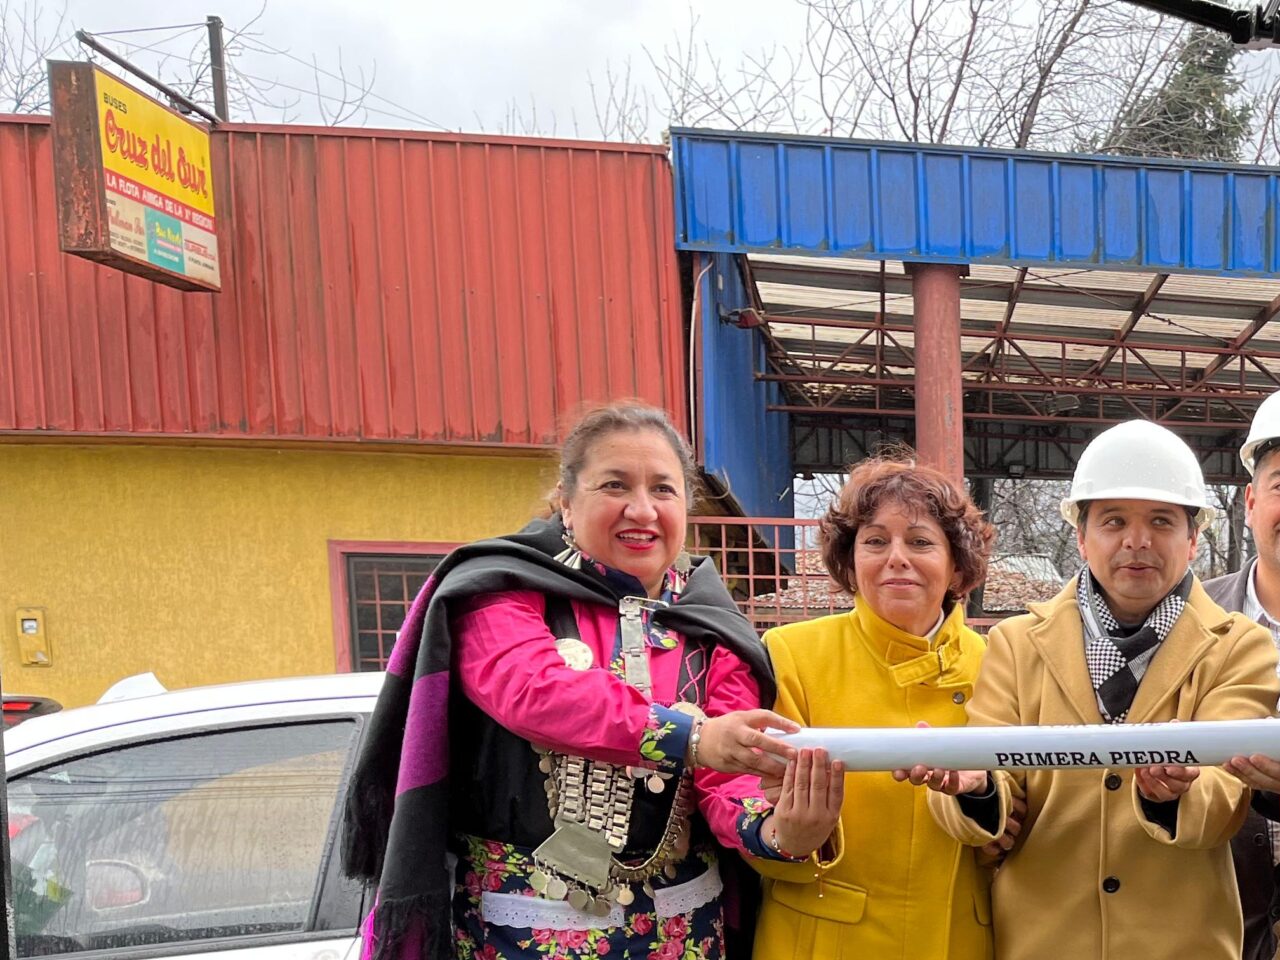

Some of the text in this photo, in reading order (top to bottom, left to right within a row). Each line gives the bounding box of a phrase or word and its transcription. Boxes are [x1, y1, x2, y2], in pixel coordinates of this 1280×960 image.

[104, 92, 127, 114] BUSES
[105, 109, 208, 199] Cruz del Sur
[106, 173, 117, 189] LA
[119, 179, 140, 199] FLOTA
[142, 189, 163, 209] AMIGA
[174, 203, 183, 218] LA
[995, 750, 1200, 766] PRIMERA PIEDRA
